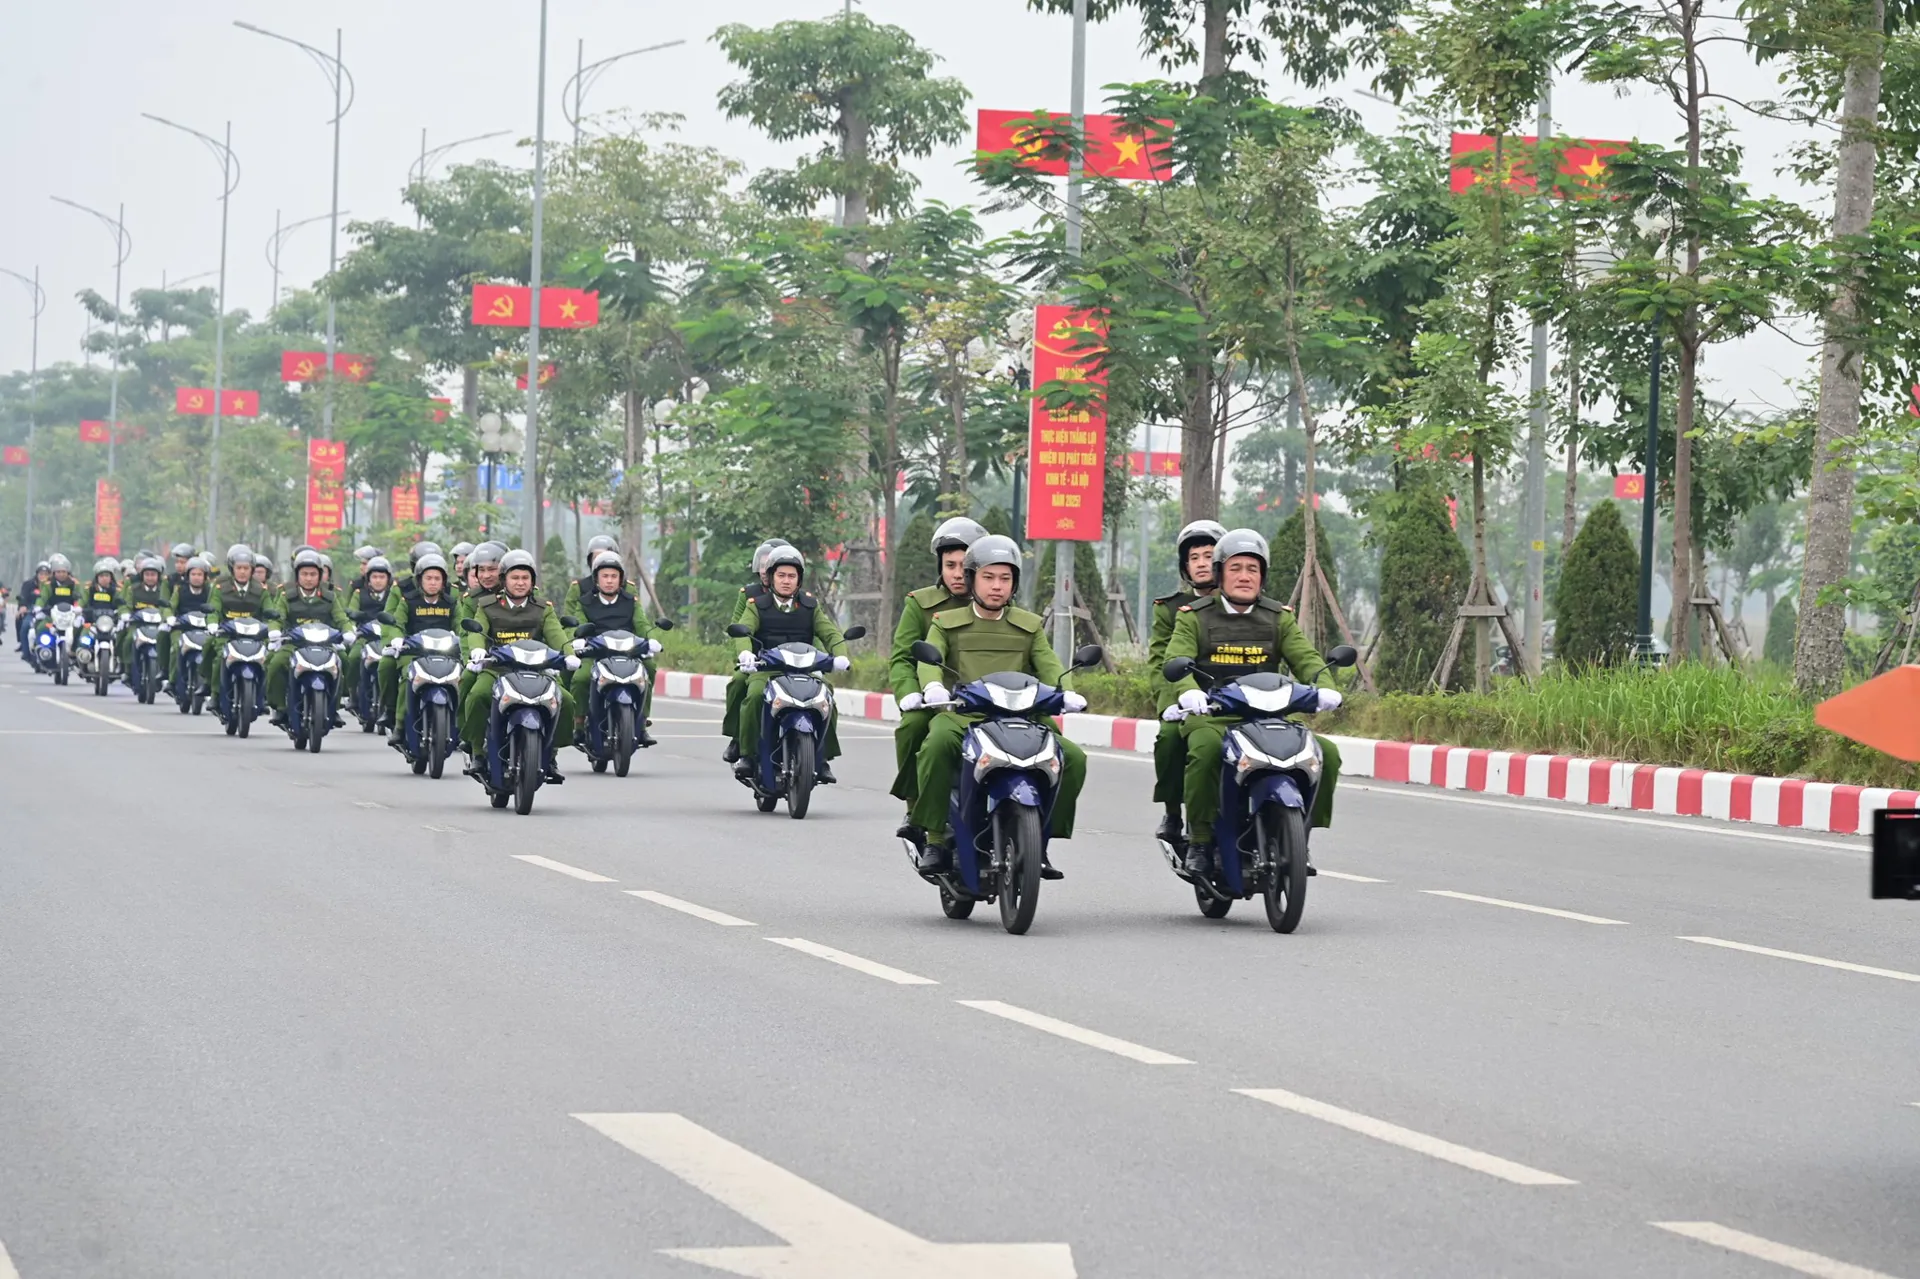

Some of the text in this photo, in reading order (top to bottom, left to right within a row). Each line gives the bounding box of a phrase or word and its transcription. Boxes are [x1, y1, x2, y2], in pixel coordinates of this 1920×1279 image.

[1039, 448, 1057, 467] NHIỆM
[1066, 449, 1080, 464] PHÁT
[1081, 447, 1097, 466] TRIỂN
[1045, 472, 1059, 485] KINH
[1059, 469, 1067, 486] TẾ
[1070, 470, 1079, 486] XÃ
[1079, 470, 1089, 489] HỘI
[1051, 491, 1064, 507] NĂM
[1217, 643, 1263, 655] CẢNH SÁT
